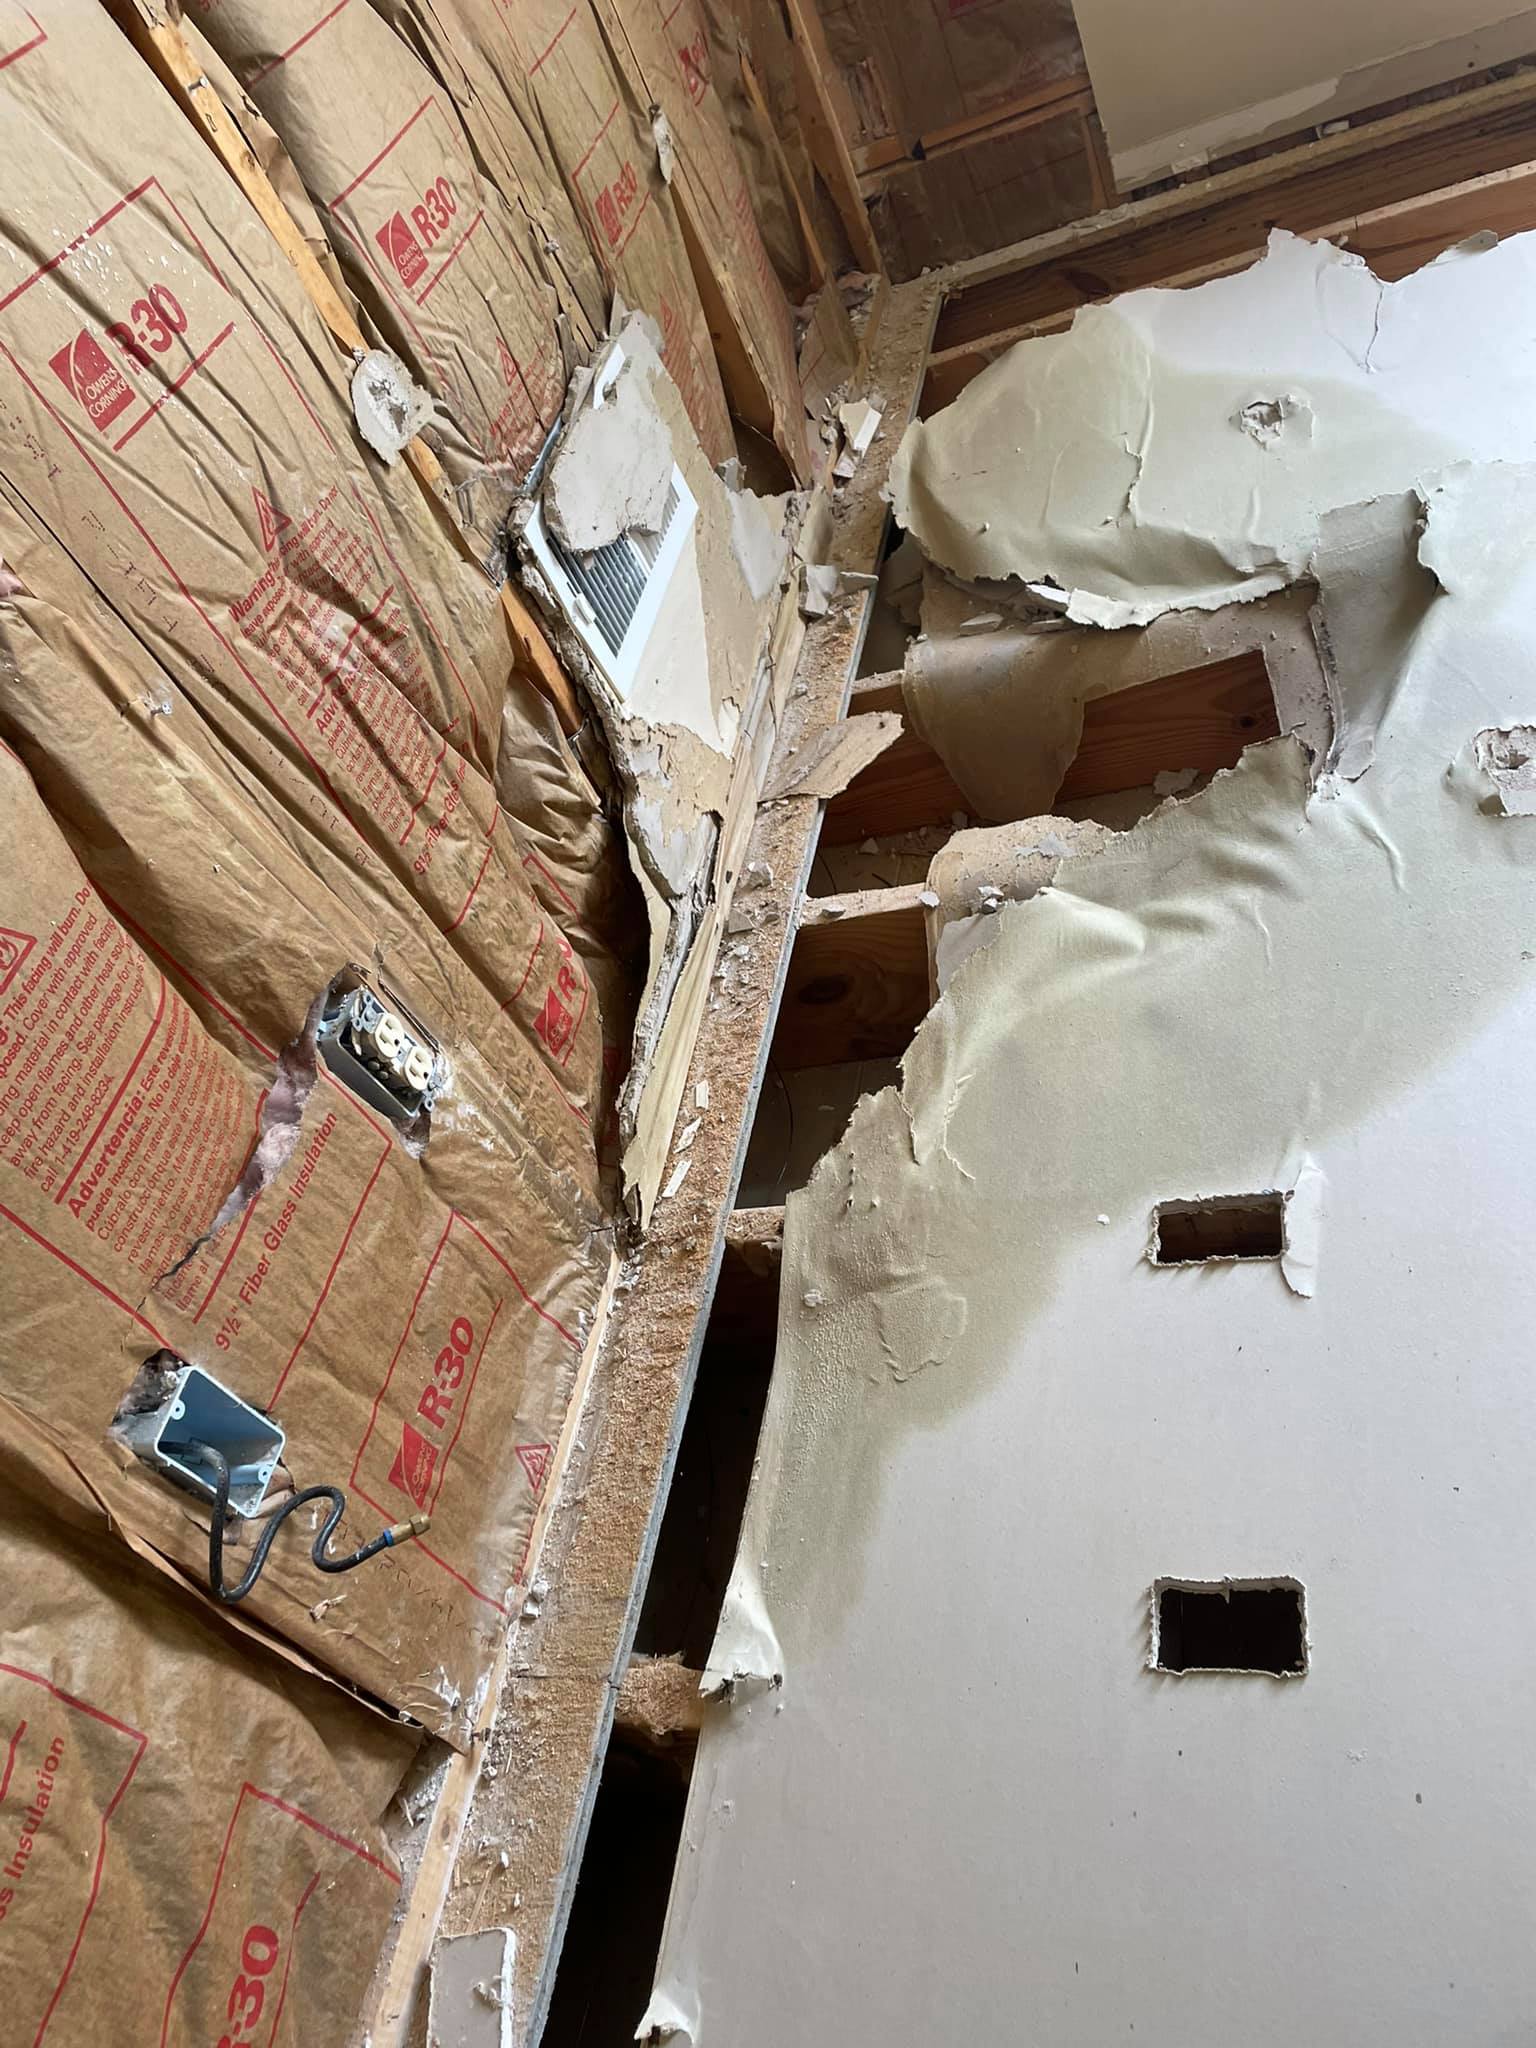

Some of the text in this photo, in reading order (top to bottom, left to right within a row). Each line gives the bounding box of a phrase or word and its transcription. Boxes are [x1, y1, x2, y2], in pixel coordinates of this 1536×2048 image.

[105, 282, 189, 374] R-30
[4, 993, 28, 1020] This
[21, 956, 52, 995] facing
[45, 932, 64, 956] will
[74, 886, 91, 905] Do
[14, 1032, 49, 1084] material
[44, 1018, 59, 1033] in
[54, 975, 84, 1020] contact
[78, 950, 99, 977] with
[21, 992, 50, 1031] Cover
[46, 966, 67, 994] with
[63, 914, 97, 968] approved
[0, 1117, 21, 1154] eep
[18, 1083, 43, 1119] open
[37, 1040, 69, 1084] flames
[63, 1014, 84, 1041] and
[78, 984, 101, 1016] other
[94, 959, 115, 985] heat
[9, 1130, 39, 1168] away
[31, 1097, 57, 1129] from
[52, 1056, 83, 1096] facing.
[75, 1029, 96, 1055] See
[92, 983, 123, 1032] package
[116, 964, 131, 983] for
[22, 1155, 44, 1180] fire
[38, 1109, 70, 1156] hazard
[66, 1082, 86, 1112] and
[80, 1022, 121, 1085] installation
[38, 1166, 59, 1193] call
[66, 1091, 145, 1219] Advertencia:
[140, 1064, 160, 1092] Este
[86, 1186, 113, 1232] puede
[108, 1115, 153, 1186] incendiarse.
[147, 1092, 164, 1111] No
[158, 1078, 171, 1093] lo
[95, 1189, 132, 1241] Cúbralo
[127, 1163, 147, 1189] con
[141, 1112, 173, 1163] material
[238, 1253, 272, 1305] Fiber
[262, 1199, 298, 1253] Glass
[288, 1112, 337, 1199] Insulation
[138, 1231, 165, 1274] llamas
[415, 1315, 476, 1429] R-30
[2, 1735, 65, 1880] Insulation
